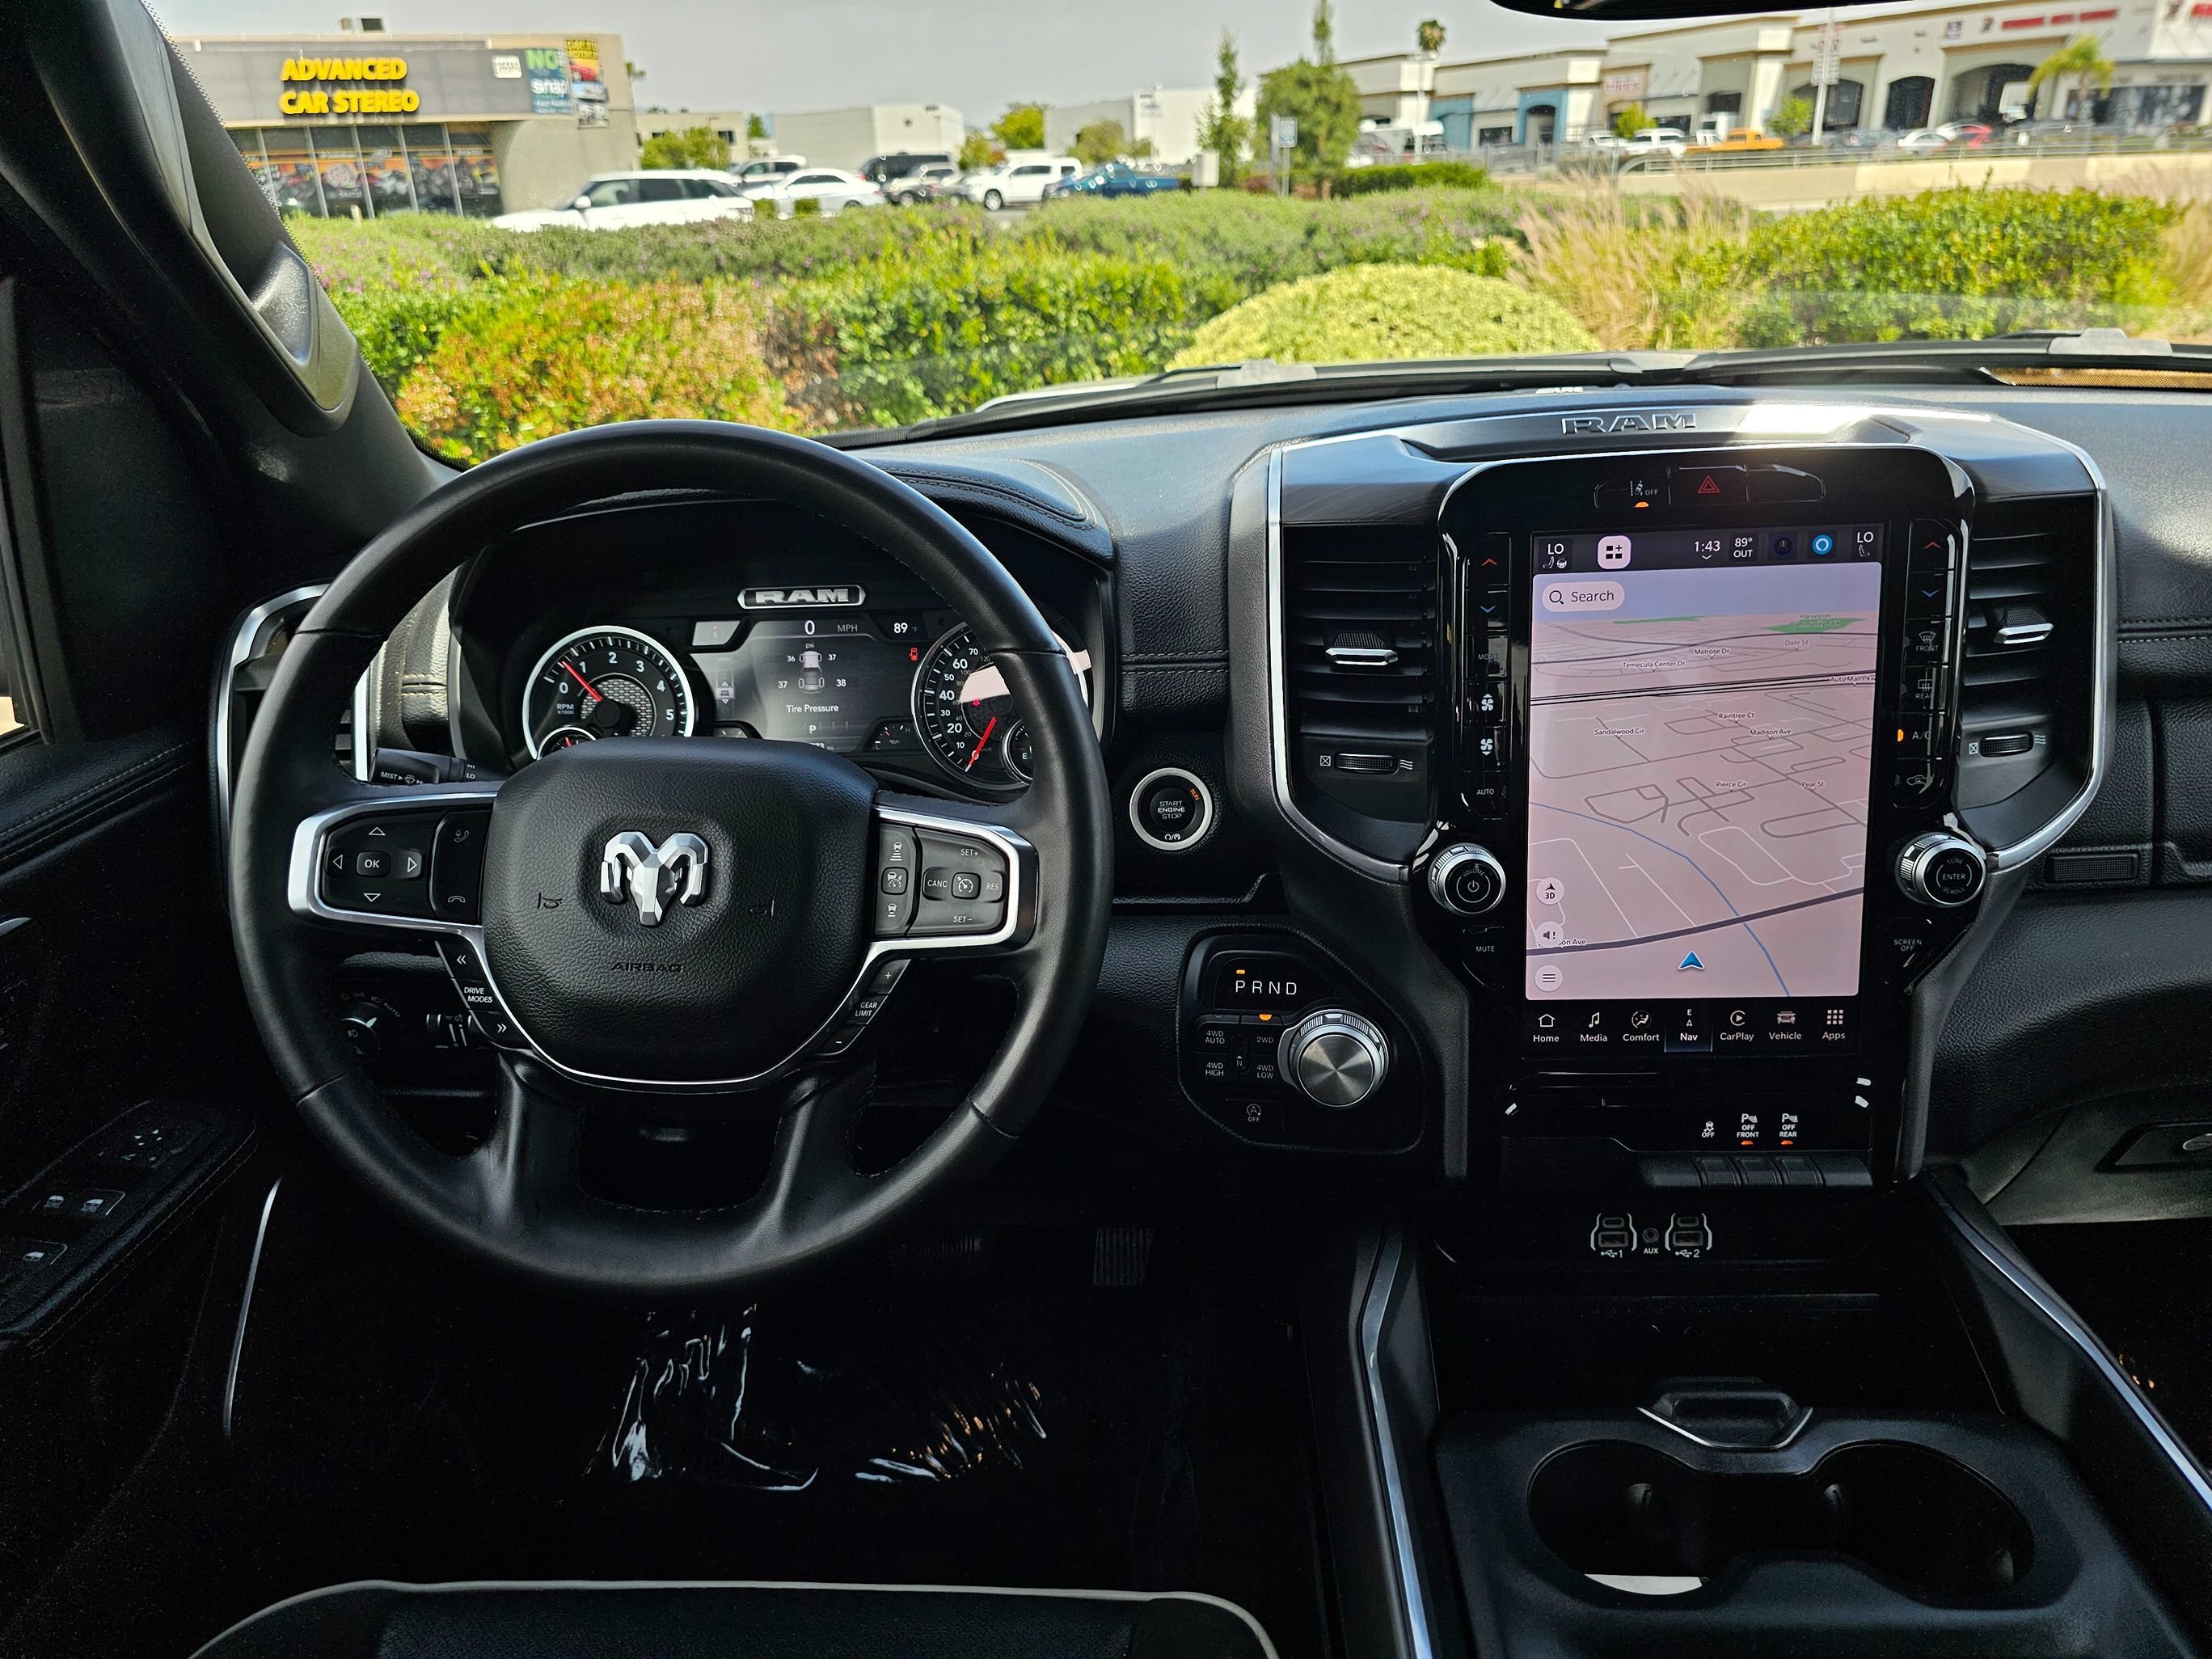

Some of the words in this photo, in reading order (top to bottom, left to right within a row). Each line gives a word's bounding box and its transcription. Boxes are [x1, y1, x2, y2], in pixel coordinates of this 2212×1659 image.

[281, 57, 407, 80] ADVANCED
[280, 90, 330, 114] CAR
[332, 89, 420, 114] STEREO
[1561, 413, 1696, 434] RAM
[1734, 537, 1753, 547] 89°
[1857, 531, 1873, 543] LO
[1547, 543, 1564, 555] LO
[1695, 540, 1720, 552] 1:43
[1733, 549, 1753, 558] OUT
[754, 589, 849, 604] RAM
[1571, 590, 1614, 602] Search
[804, 620, 815, 635] 0
[838, 623, 858, 633] MPH
[893, 623, 908, 633] 89
[609, 652, 617, 663] 2
[580, 661, 586, 673] 1
[636, 661, 644, 672] 3
[952, 659, 968, 669] 60
[559, 682, 568, 694] 0
[656, 680, 665, 691] 4
[778, 681, 788, 689] 37
[836, 679, 846, 687] 38
[939, 690, 955, 700] 40
[786, 704, 802, 713] Tire
[804, 703, 839, 713] Pressure
[666, 709, 674, 720] 5
[809, 724, 817, 734] P
[947, 723, 962, 733] 20
[1594, 728, 1634, 736] Sandalwood
[1912, 730, 1931, 740] A/C
[381, 771, 398, 780] MIST
[365, 859, 380, 868] OK
[1462, 868, 1486, 878] VOLUME
[927, 880, 948, 888] CANC
[611, 963, 682, 973] AIRBAG
[464, 986, 485, 994] DRIVE
[1235, 980, 1245, 993] P
[1252, 981, 1262, 994] R
[1269, 981, 1280, 994] N
[1286, 982, 1297, 994] D
[467, 995, 493, 1003] MODES
[1533, 1034, 1560, 1042] Home
[1580, 1033, 1607, 1042] Media
[1623, 1033, 1660, 1041] Comfort
[1680, 1033, 1698, 1041] Nav
[1720, 1032, 1754, 1042] CarPlay
[1769, 1032, 1802, 1041] Vehicle
[1822, 1032, 1845, 1041] Apps
[1693, 1249, 1699, 1258] 2
